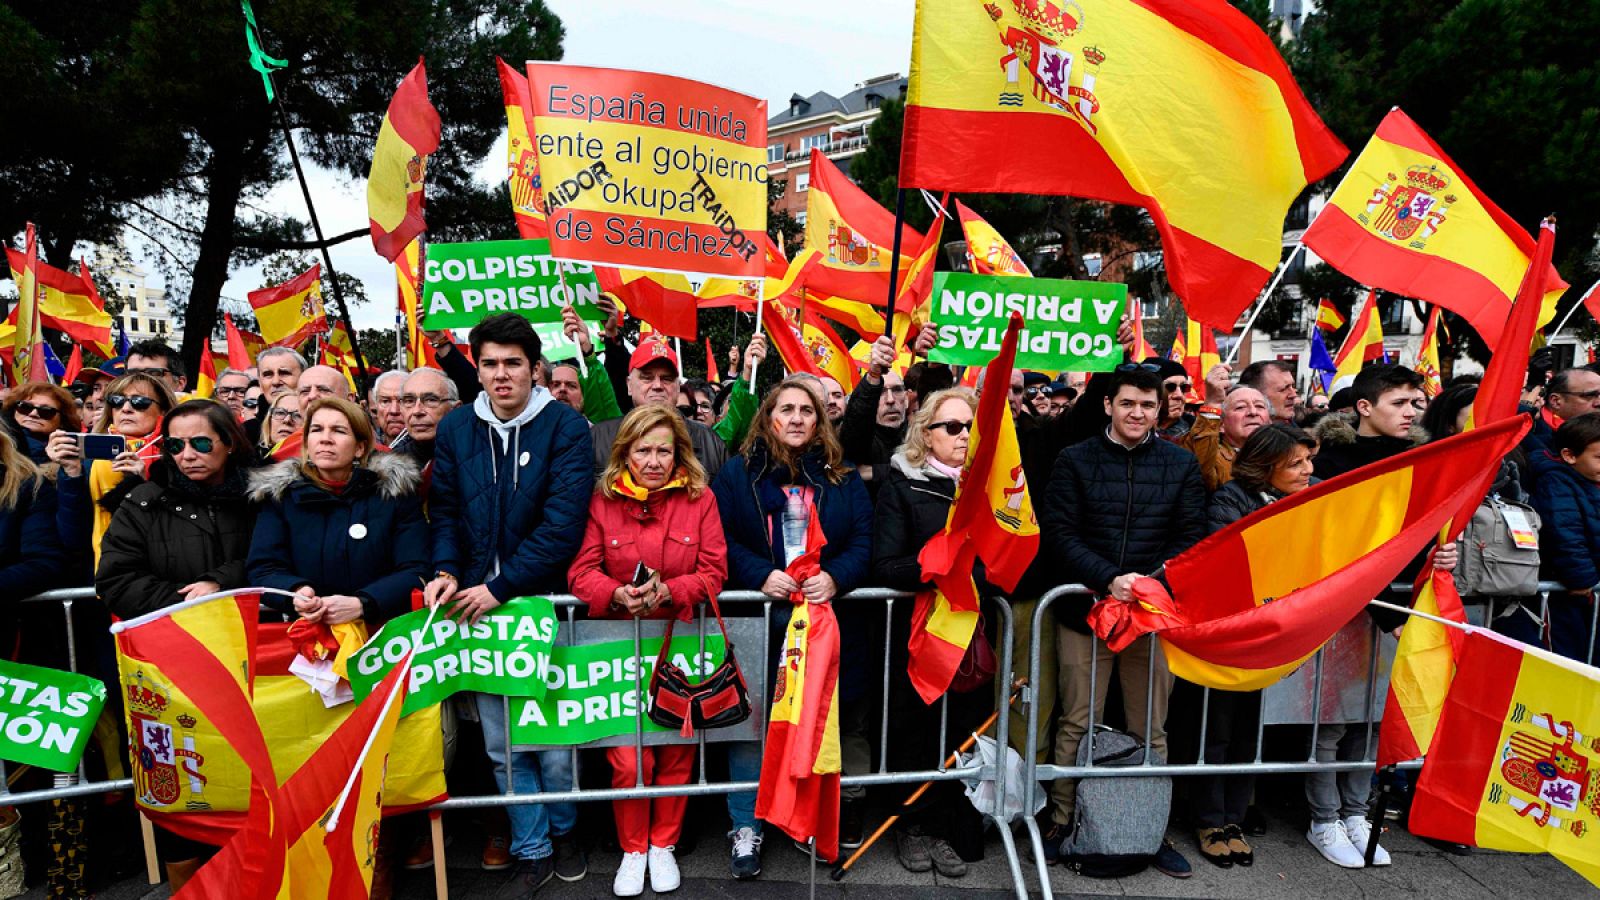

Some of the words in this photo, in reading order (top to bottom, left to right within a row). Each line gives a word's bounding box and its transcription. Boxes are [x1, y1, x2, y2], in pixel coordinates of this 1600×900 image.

[548, 85, 666, 123] España
[678, 105, 747, 142] unida
[536, 131, 604, 160] ente
[615, 136, 641, 164] al
[653, 144, 767, 184] gobierno
[602, 177, 695, 216] okupa
[555, 213, 593, 242] de
[604, 217, 734, 258] Sánchez
[429, 291, 455, 315] A
[461, 278, 600, 313] PRISIÓN
[940, 289, 1083, 324] PRISIÓN
[1092, 299, 1119, 325] A
[939, 325, 1113, 358] GOLPITAS
[357, 615, 554, 676] GOLPISTAS
[409, 643, 550, 694] PRISIÓN
[547, 651, 714, 690] OLPISAS
[518, 700, 548, 727] A
